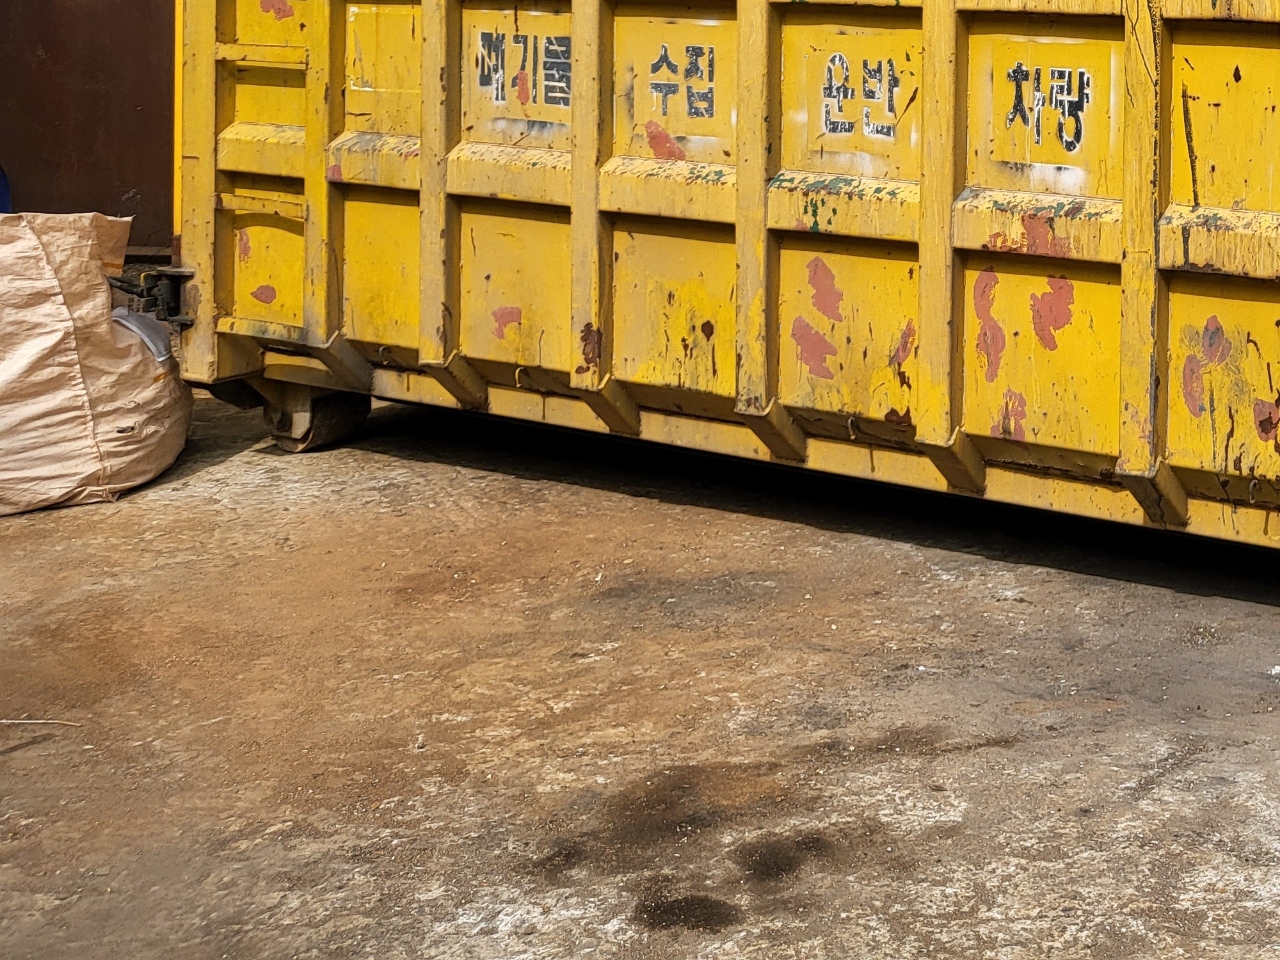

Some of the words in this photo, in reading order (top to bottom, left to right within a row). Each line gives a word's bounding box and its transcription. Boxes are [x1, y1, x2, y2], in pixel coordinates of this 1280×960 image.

[479, 31, 572, 107] 폐기물
[650, 43, 715, 119] 수집
[823, 52, 900, 139] 운반
[1006, 60, 1091, 152] 차량
